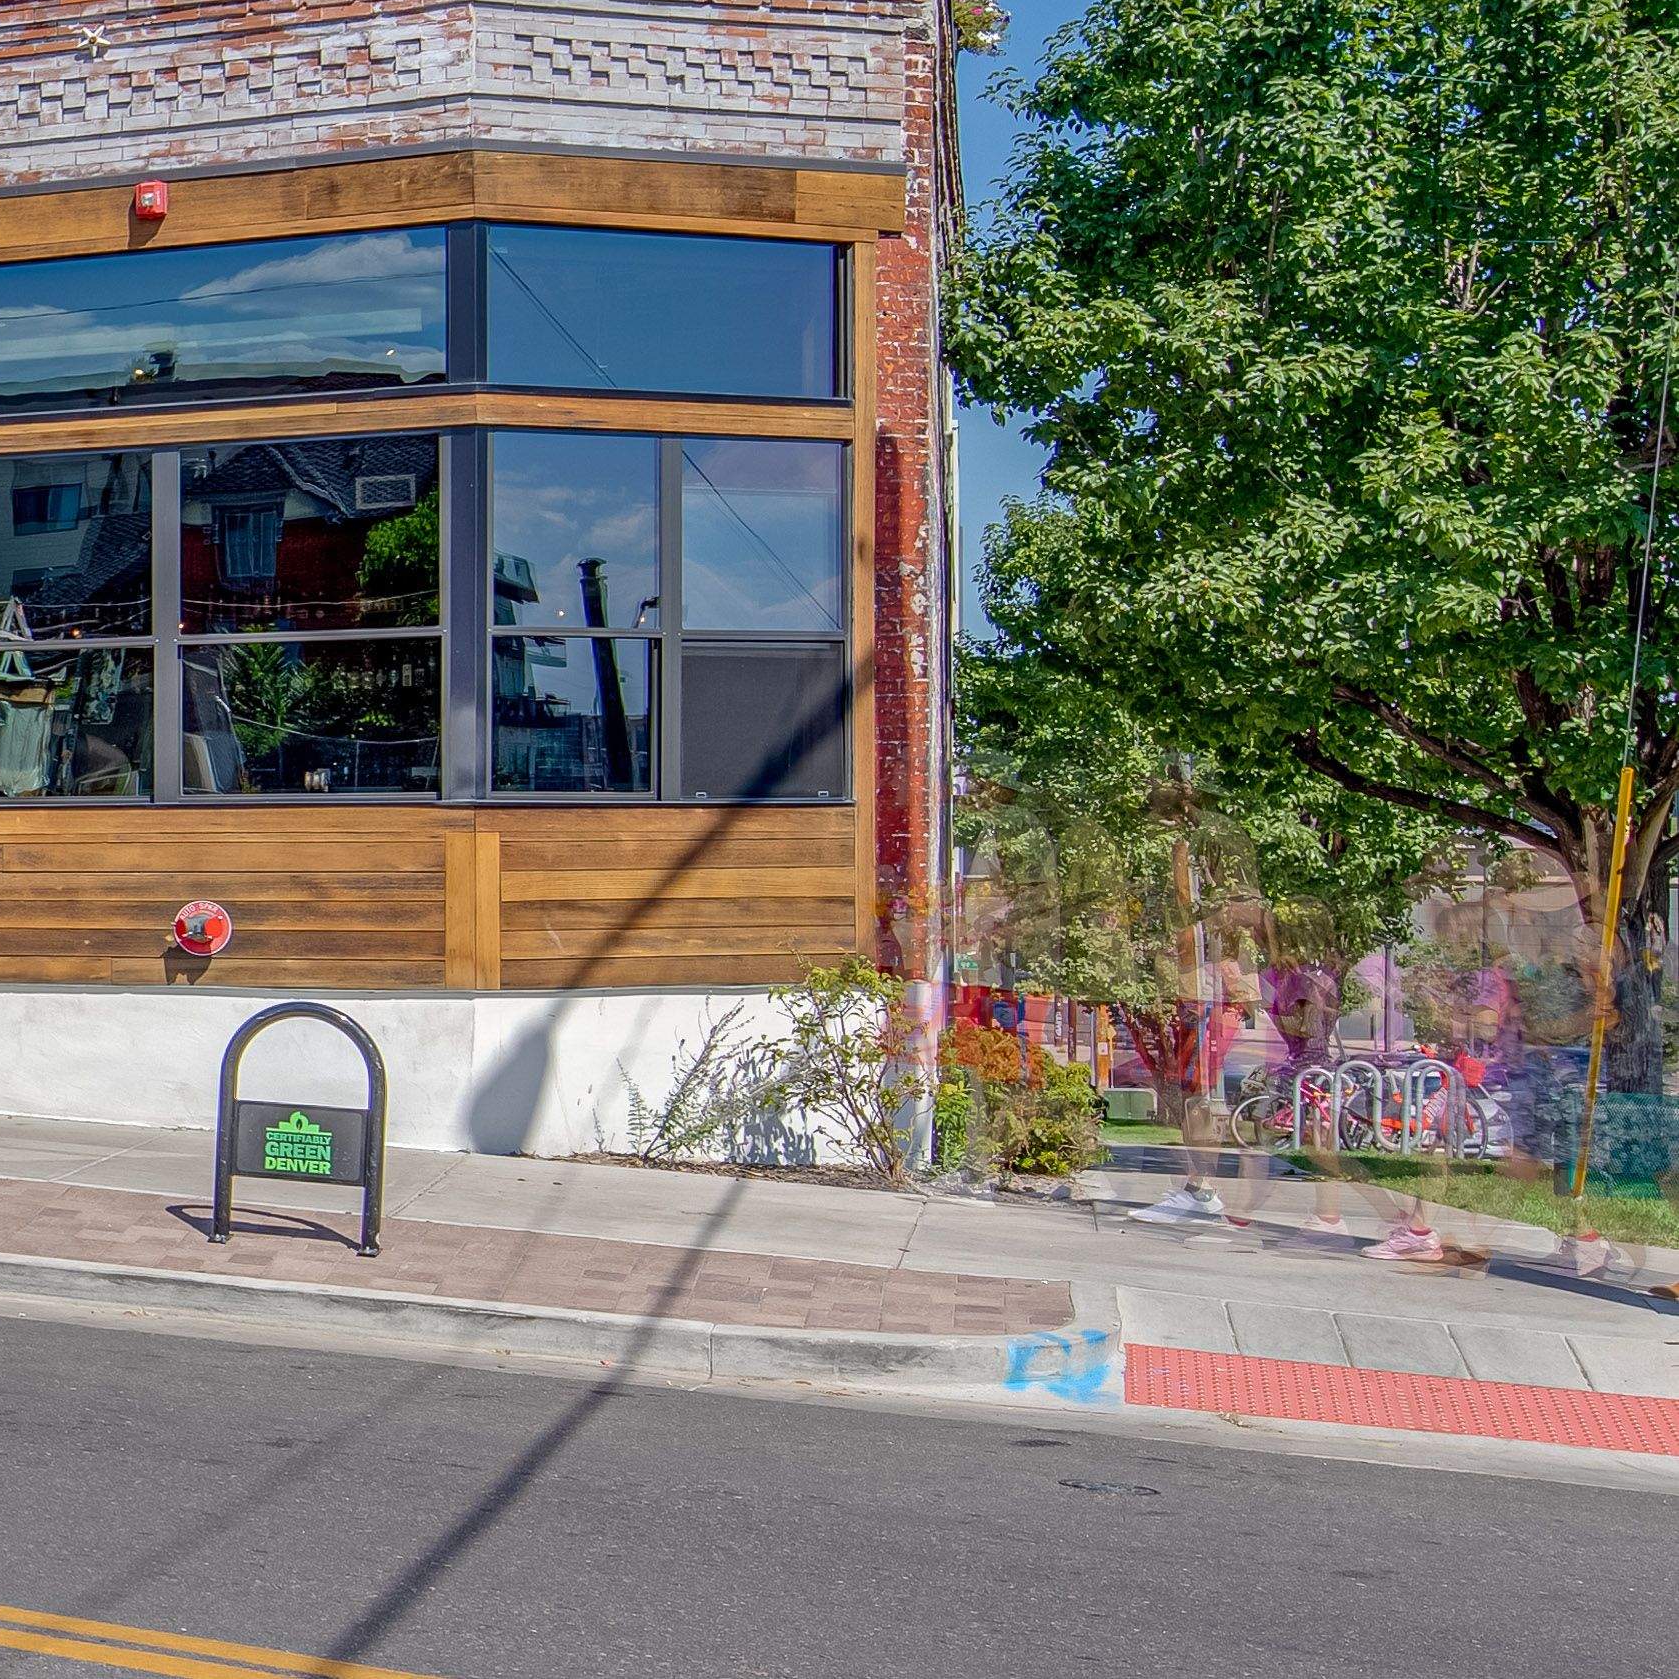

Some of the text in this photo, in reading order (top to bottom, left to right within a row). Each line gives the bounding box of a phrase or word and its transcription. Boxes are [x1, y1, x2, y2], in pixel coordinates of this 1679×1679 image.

[266, 1132, 331, 1146] CERTIFIABLY
[265, 1140, 331, 1161] GREEN
[265, 1156, 331, 1175] DENVER
